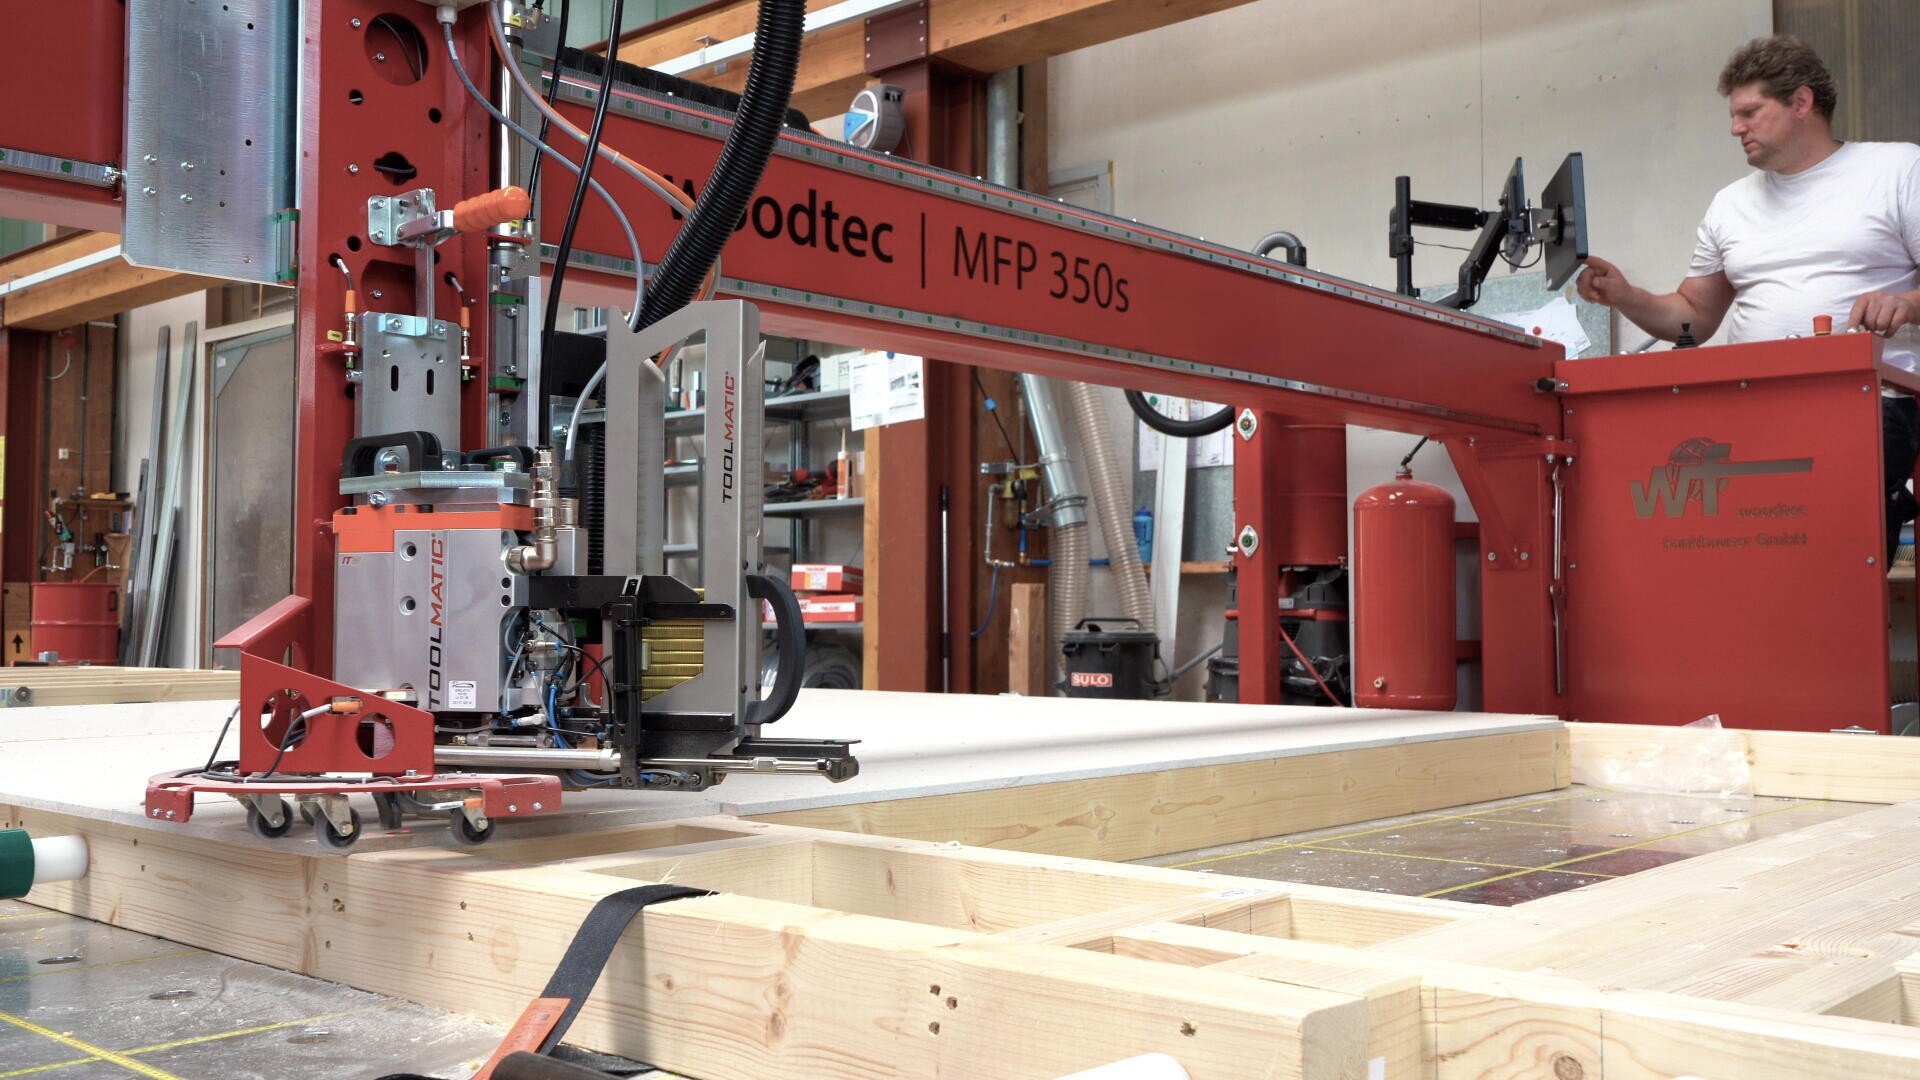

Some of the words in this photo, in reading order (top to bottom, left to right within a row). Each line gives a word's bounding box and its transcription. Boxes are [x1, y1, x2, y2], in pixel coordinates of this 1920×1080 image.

[953, 226, 1038, 290] MFP
[1049, 251, 1130, 313] 350s
[722, 374, 735, 503] TOOLMATIC
[428, 537, 444, 710] TOOLMATIC
[1072, 673, 1109, 685] SULO
